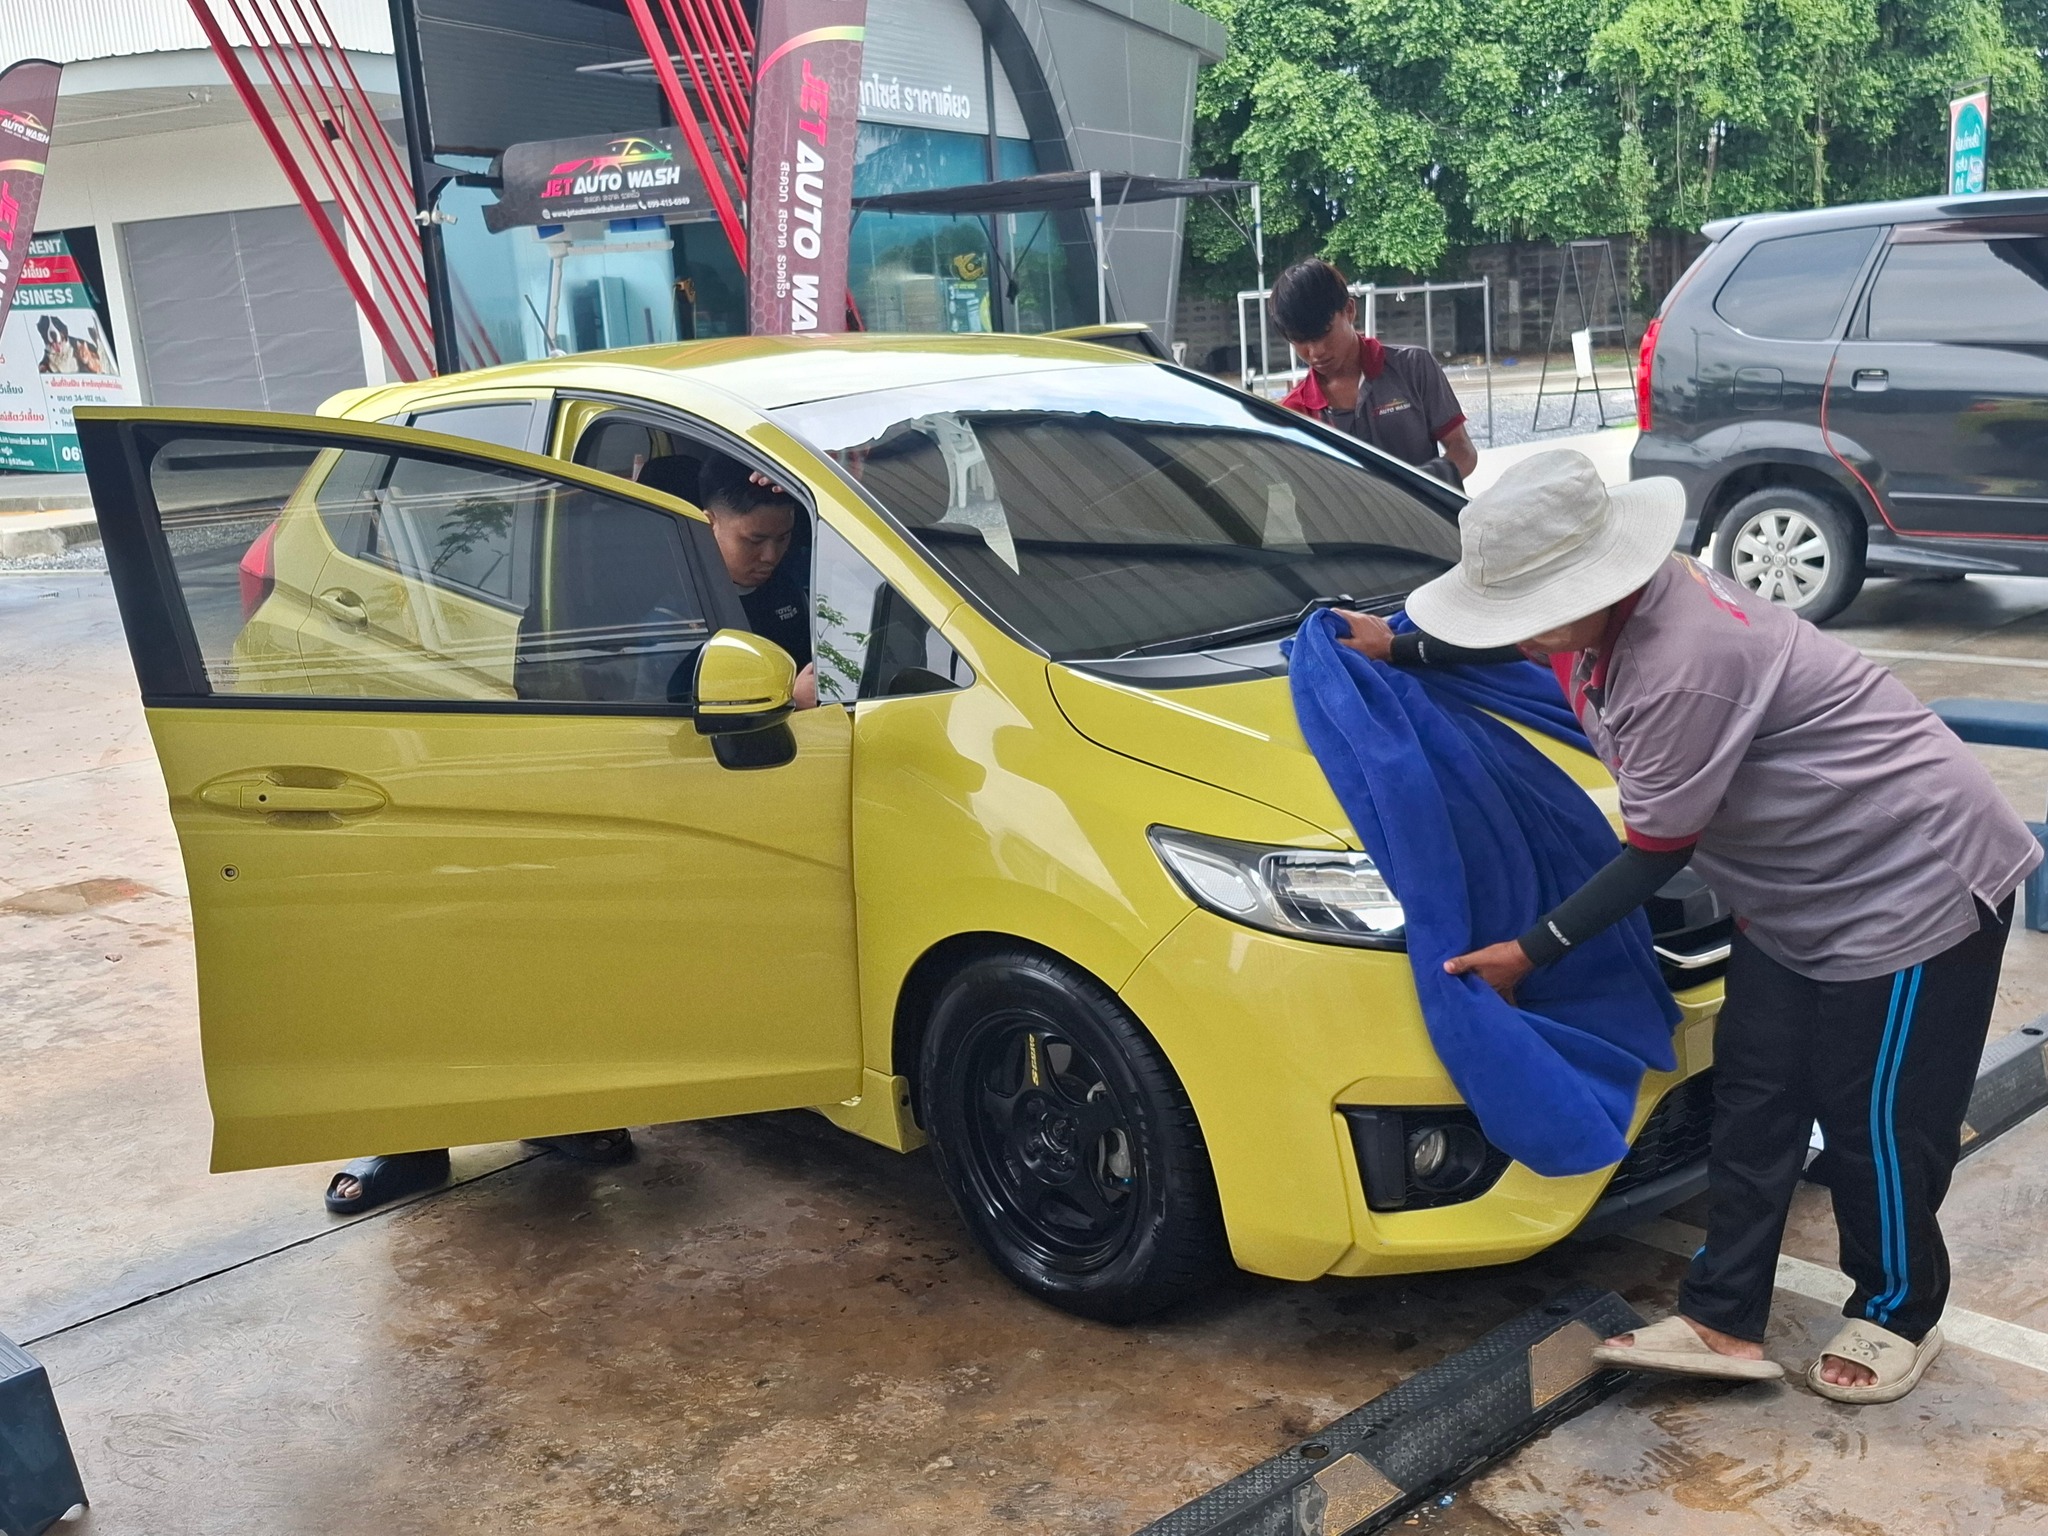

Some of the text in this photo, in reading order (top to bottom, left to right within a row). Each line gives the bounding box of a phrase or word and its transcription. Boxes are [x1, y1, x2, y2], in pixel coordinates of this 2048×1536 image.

[904, 84, 970, 119] ราคาเดียว
[1, 118, 25, 134] AUTO
[25, 127, 50, 144] WASH
[541, 166, 681, 198] JET AUTO WASH
[791, 58, 830, 334] JET AUTO WA
[776, 161, 790, 298] สะดวก สะอาด รวดเร็ว
[29, 239, 61, 254] RENT
[12, 288, 73, 306] USINESS
